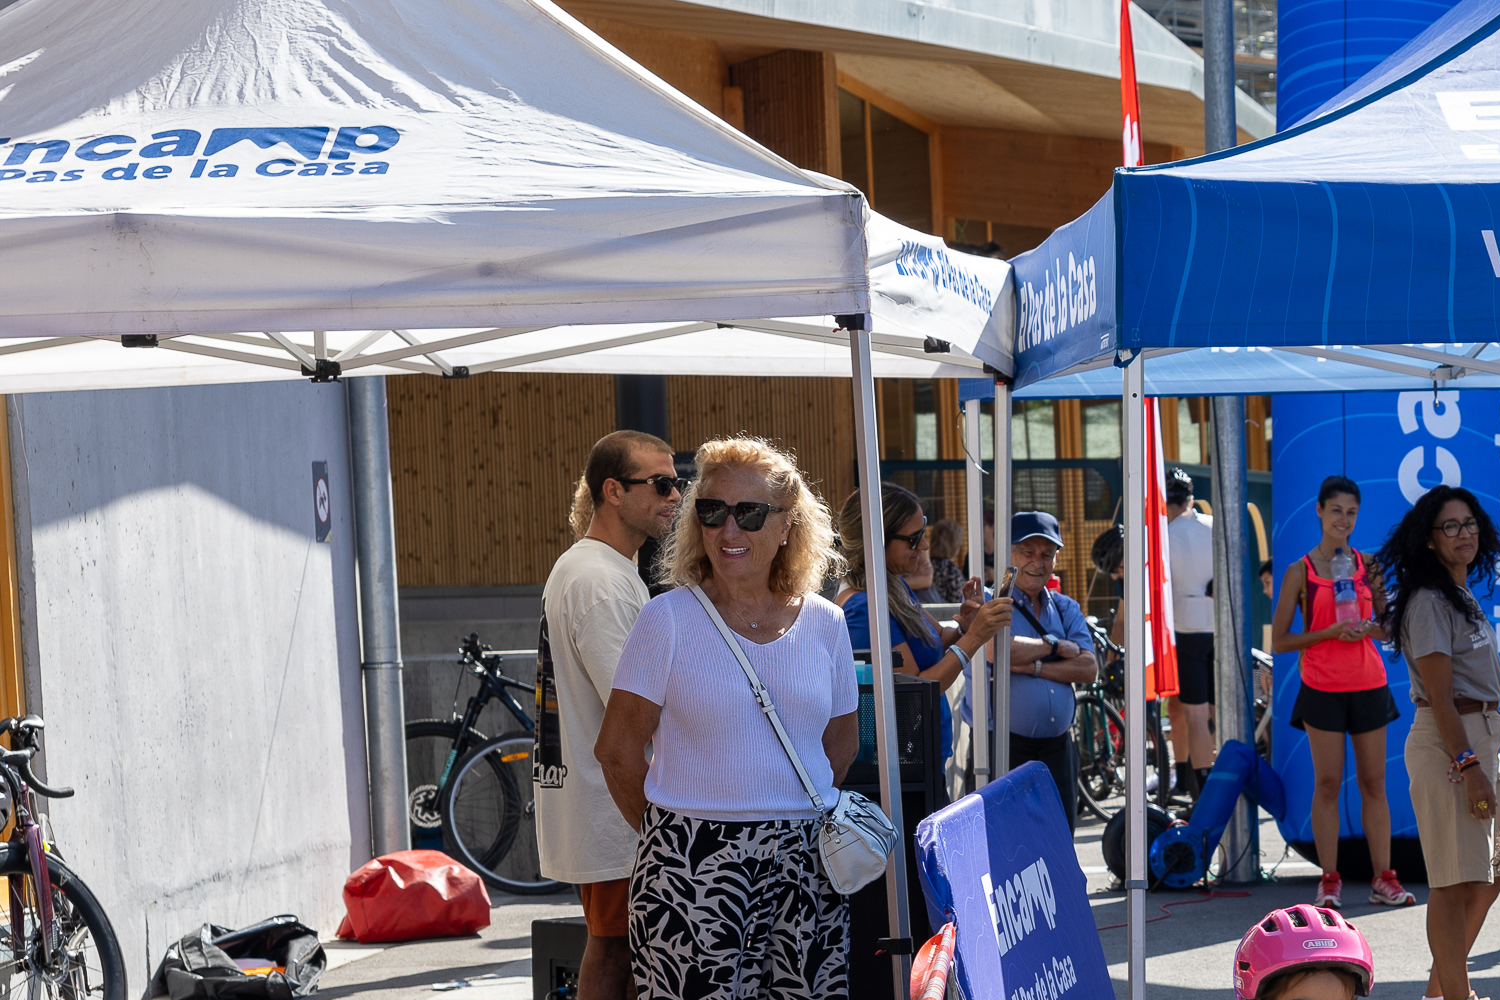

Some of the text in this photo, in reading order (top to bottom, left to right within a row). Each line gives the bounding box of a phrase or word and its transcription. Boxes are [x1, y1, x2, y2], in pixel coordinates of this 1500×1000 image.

[0, 125, 401, 167] ncamp
[101, 162, 173, 181] de
[190, 158, 240, 178] la
[255, 158, 390, 177] Casa
[1027, 281, 1043, 349] Pas
[1043, 269, 1056, 342] de
[1056, 257, 1067, 334] la
[1068, 251, 1097, 328] Casa
[981, 856, 1057, 957] Encamp
[1307, 940, 1334, 948] ABUS
[1052, 955, 1077, 995] Casa
